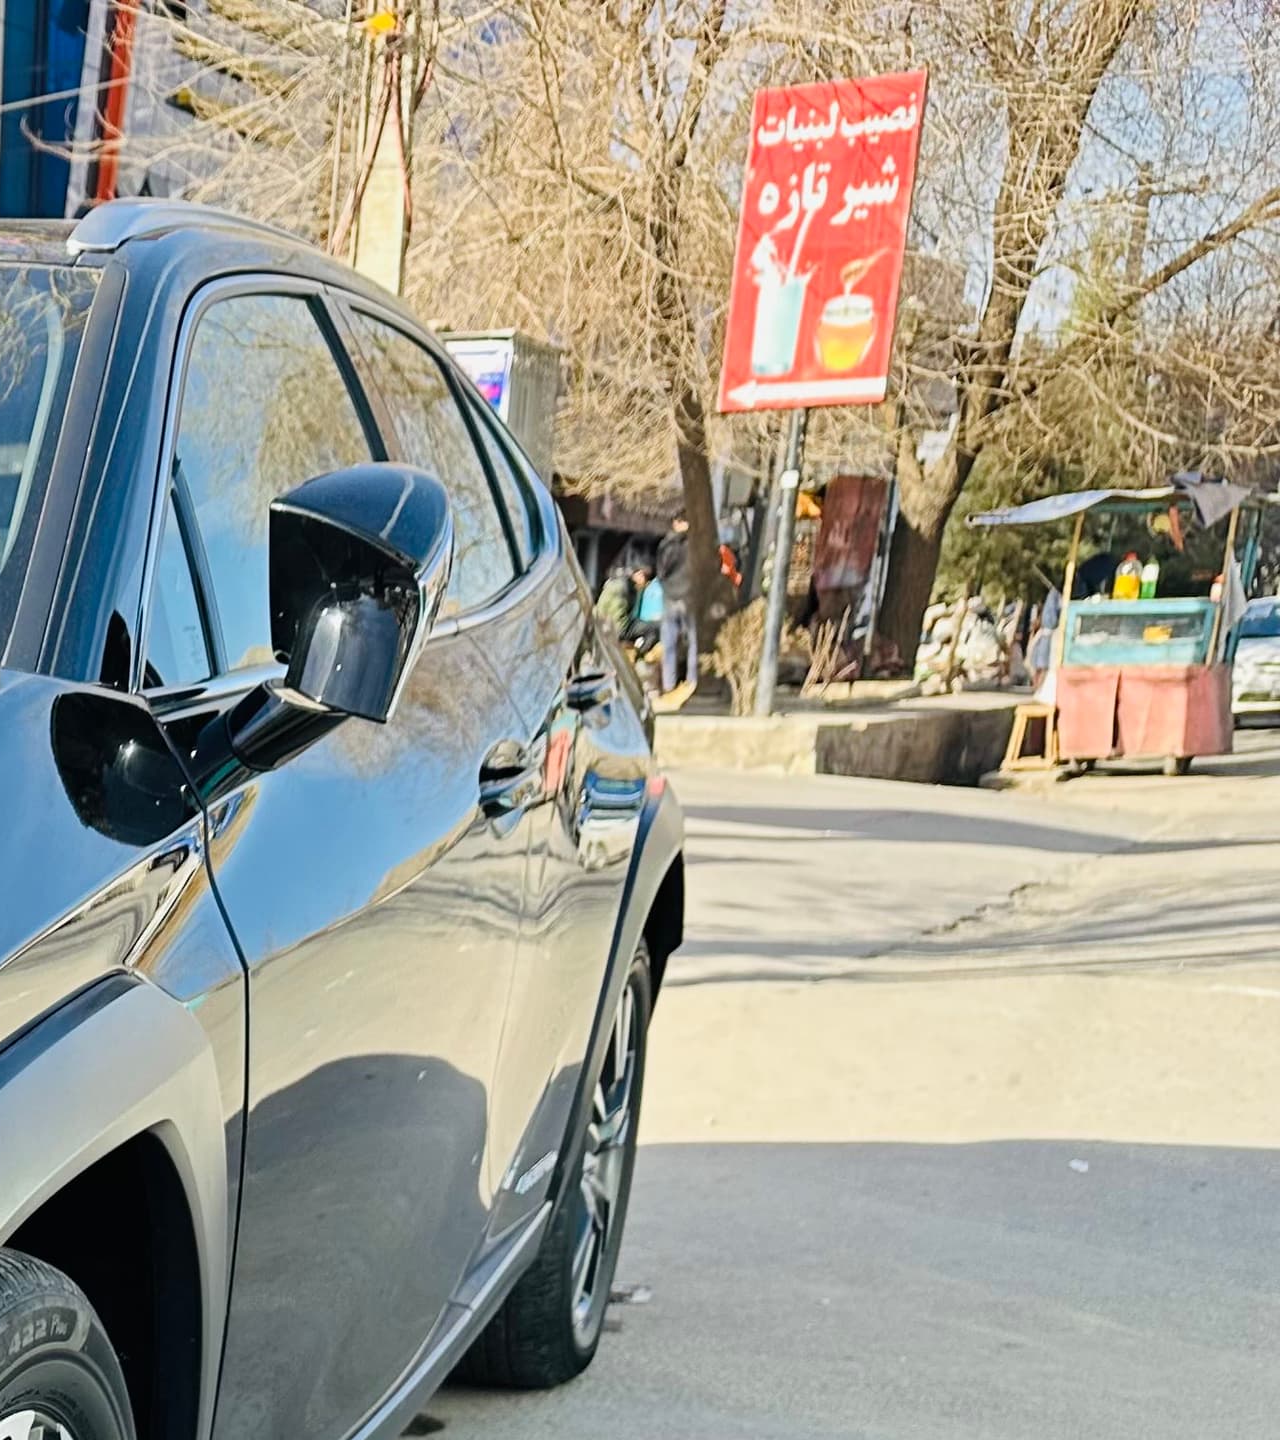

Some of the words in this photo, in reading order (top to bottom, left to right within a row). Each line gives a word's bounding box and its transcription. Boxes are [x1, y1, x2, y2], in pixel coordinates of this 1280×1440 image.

[757, 100, 840, 152] لبنیات
[841, 92, 918, 147] نصیب
[757, 161, 832, 232] تازه
[829, 155, 900, 226] شیر
[8, 1318, 48, 1356] 422
